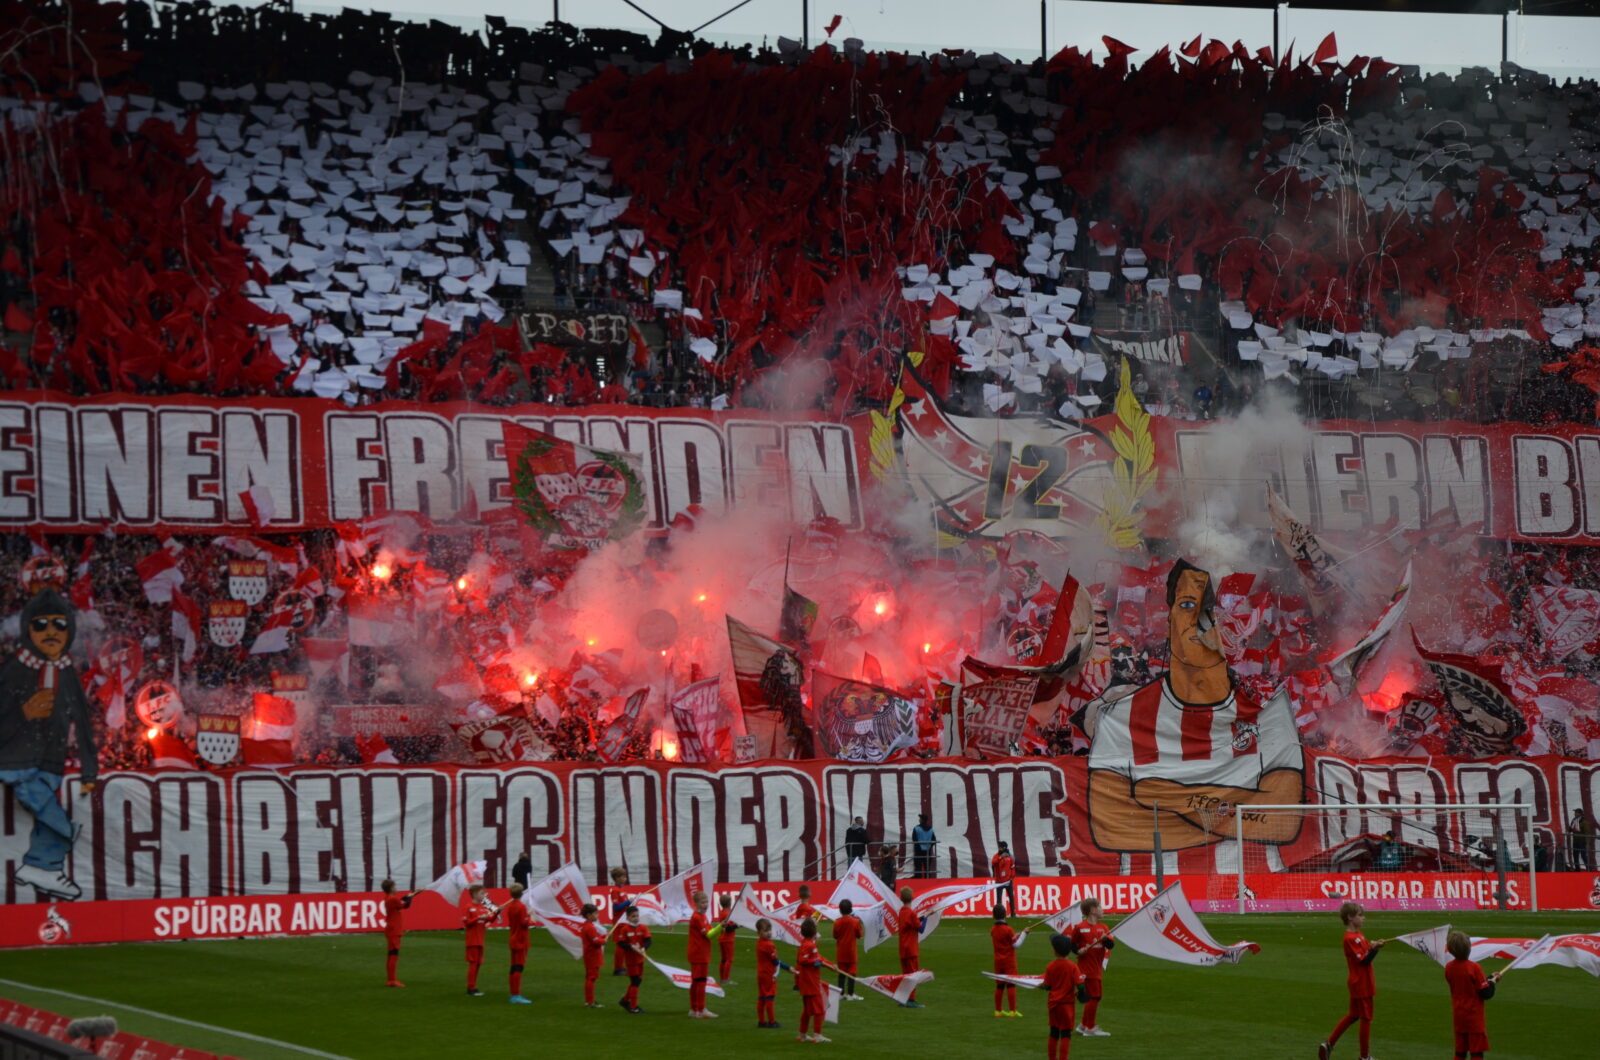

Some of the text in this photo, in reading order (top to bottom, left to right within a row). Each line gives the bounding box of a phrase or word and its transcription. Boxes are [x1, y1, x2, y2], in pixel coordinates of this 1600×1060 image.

[984, 440, 1069, 520] 12
[233, 768, 451, 895] BEIM
[569, 766, 668, 887] IN
[666, 766, 822, 885] DER
[823, 762, 1075, 878] KURVE
[154, 900, 282, 936] SPÜRBAR
